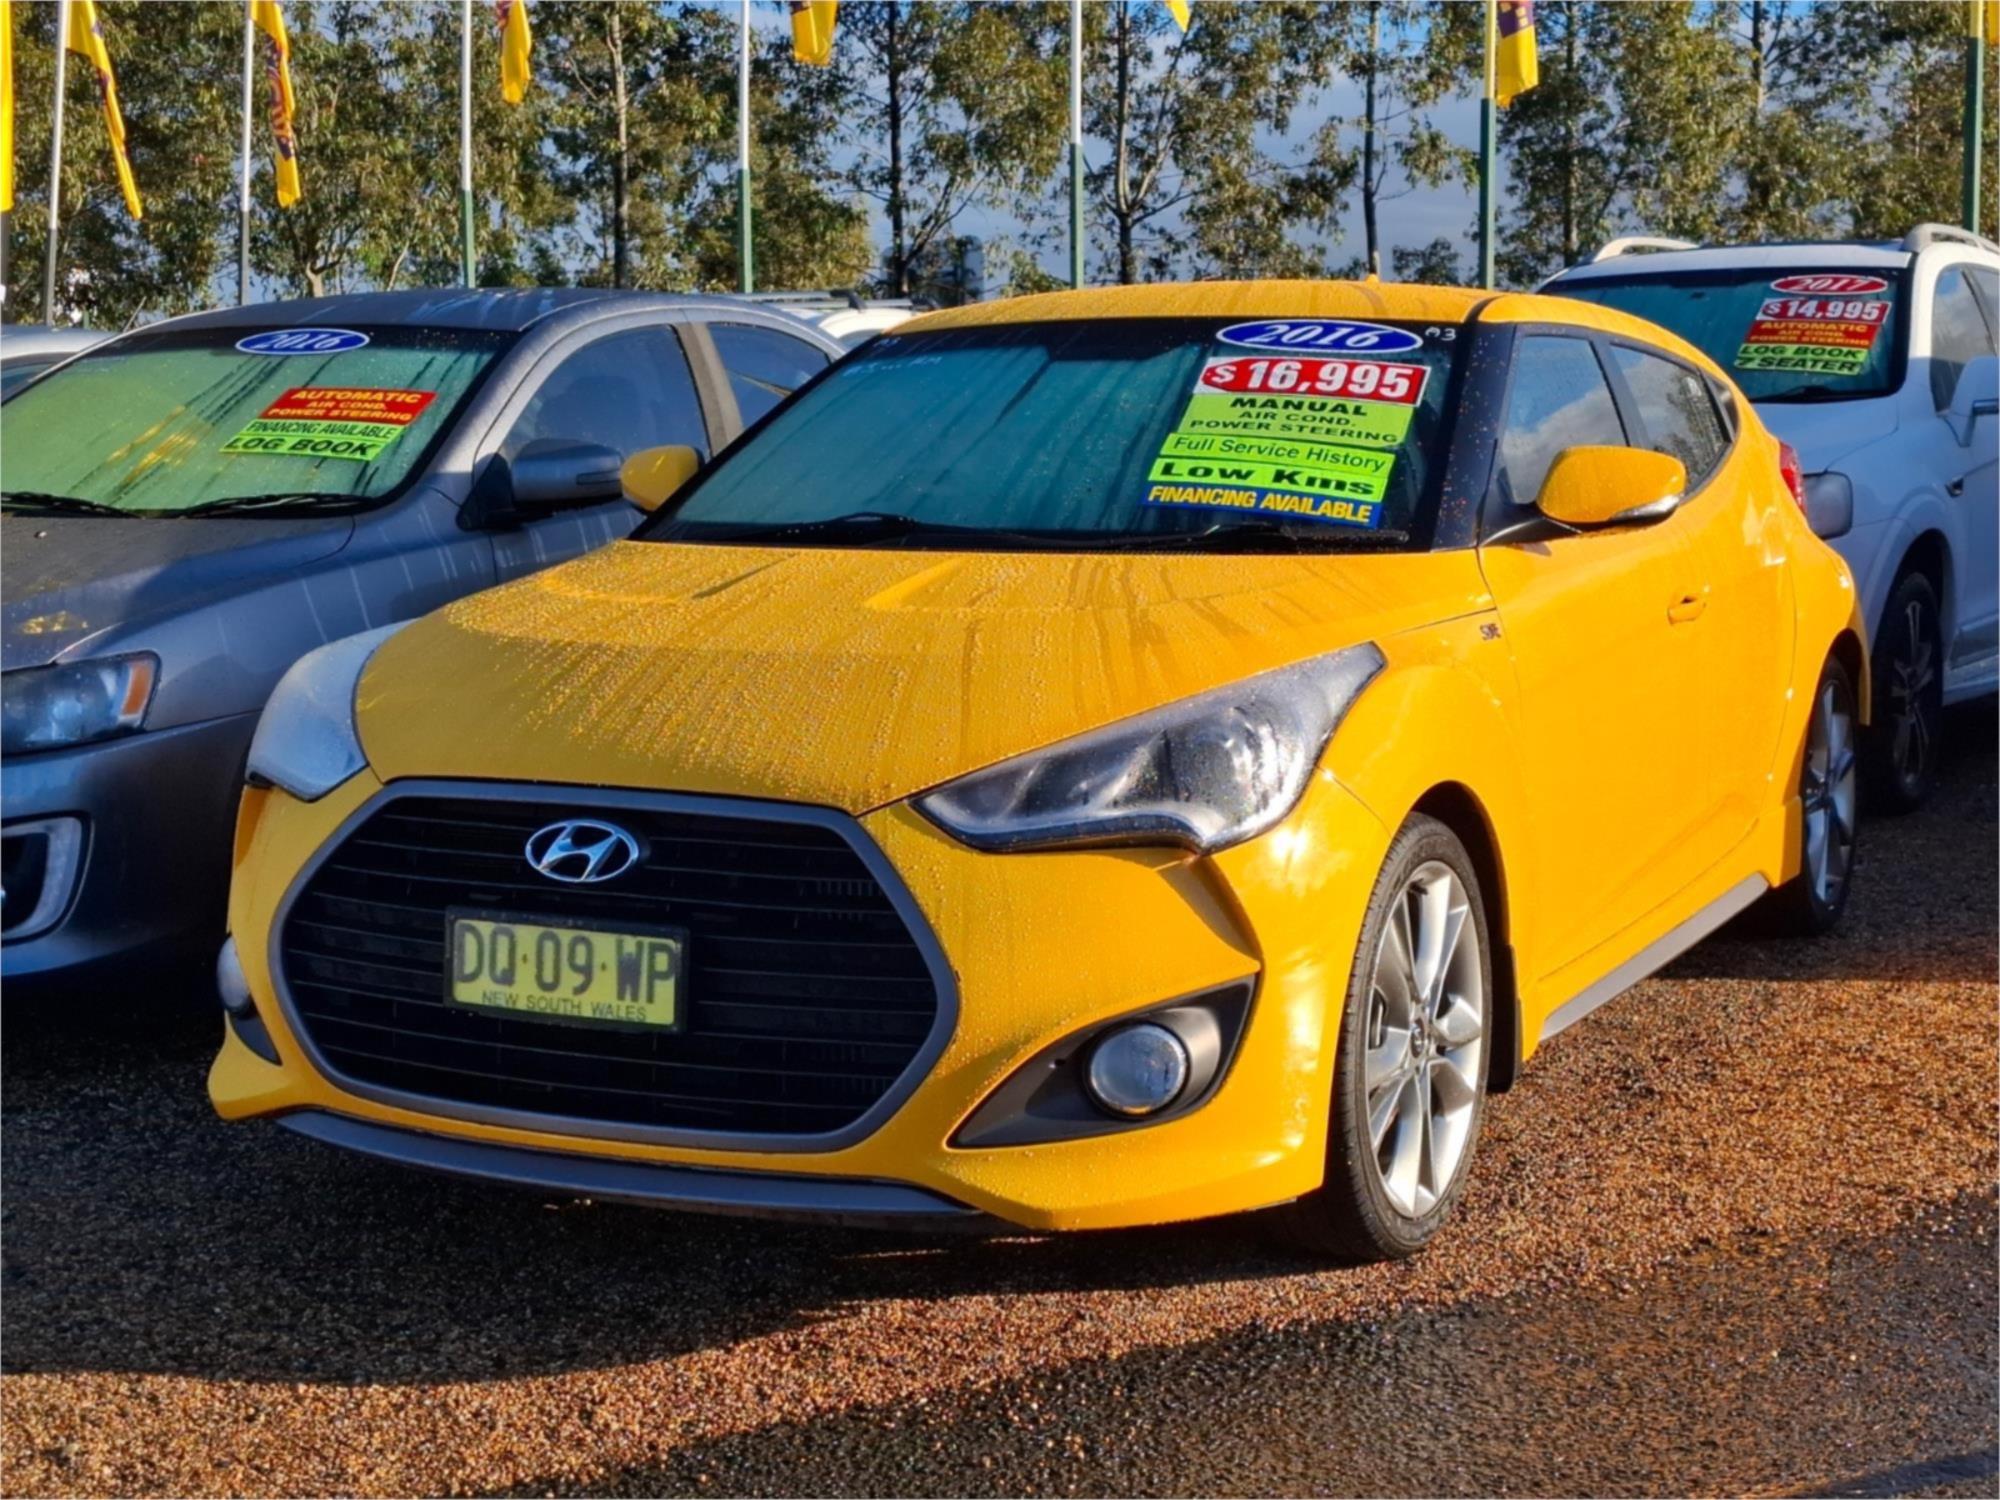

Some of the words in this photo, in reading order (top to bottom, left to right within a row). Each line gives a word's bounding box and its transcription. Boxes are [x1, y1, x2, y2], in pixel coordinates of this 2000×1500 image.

[1790, 278, 1869, 291] 2017
[1767, 301, 1881, 320] $14,995
[1247, 324, 1386, 349] 2016
[1761, 322, 1869, 333] AUTOMATIC
[253, 333, 345, 349] 2016
[1801, 336, 1871, 346] STEERING
[1740, 345, 1787, 355] LOG
[1792, 346, 1863, 359] BOOK
[1736, 357, 1752, 366] 7
[1756, 357, 1857, 372] SEATER
[1210, 361, 1414, 398] $16,995
[291, 390, 422, 404] AUTOMATIC
[306, 400, 337, 408] AIR
[1230, 397, 1369, 416] MANUAL
[267, 408, 324, 417] POWER
[329, 409, 414, 420] STEERING
[1239, 411, 1279, 421] AIR
[1285, 412, 1356, 427] COND.
[246, 420, 318, 435] FINANCING
[318, 422, 396, 439] AVAILABLE
[1190, 419, 1272, 432] POWER
[1279, 423, 1398, 442] STEERING
[224, 436, 284, 451] LOG
[287, 439, 380, 456] BOOK
[1173, 437, 1215, 452] Full
[1220, 439, 1299, 459] Service
[1307, 447, 1386, 473] History
[1272, 468, 1375, 496] Kms
[1148, 486, 1258, 508] FINANCING
[1260, 494, 1372, 523] AVAILABLE
[481, 991, 517, 1007] NEW
[525, 994, 582, 1014] SOUTH
[590, 1003, 647, 1021] WALES
